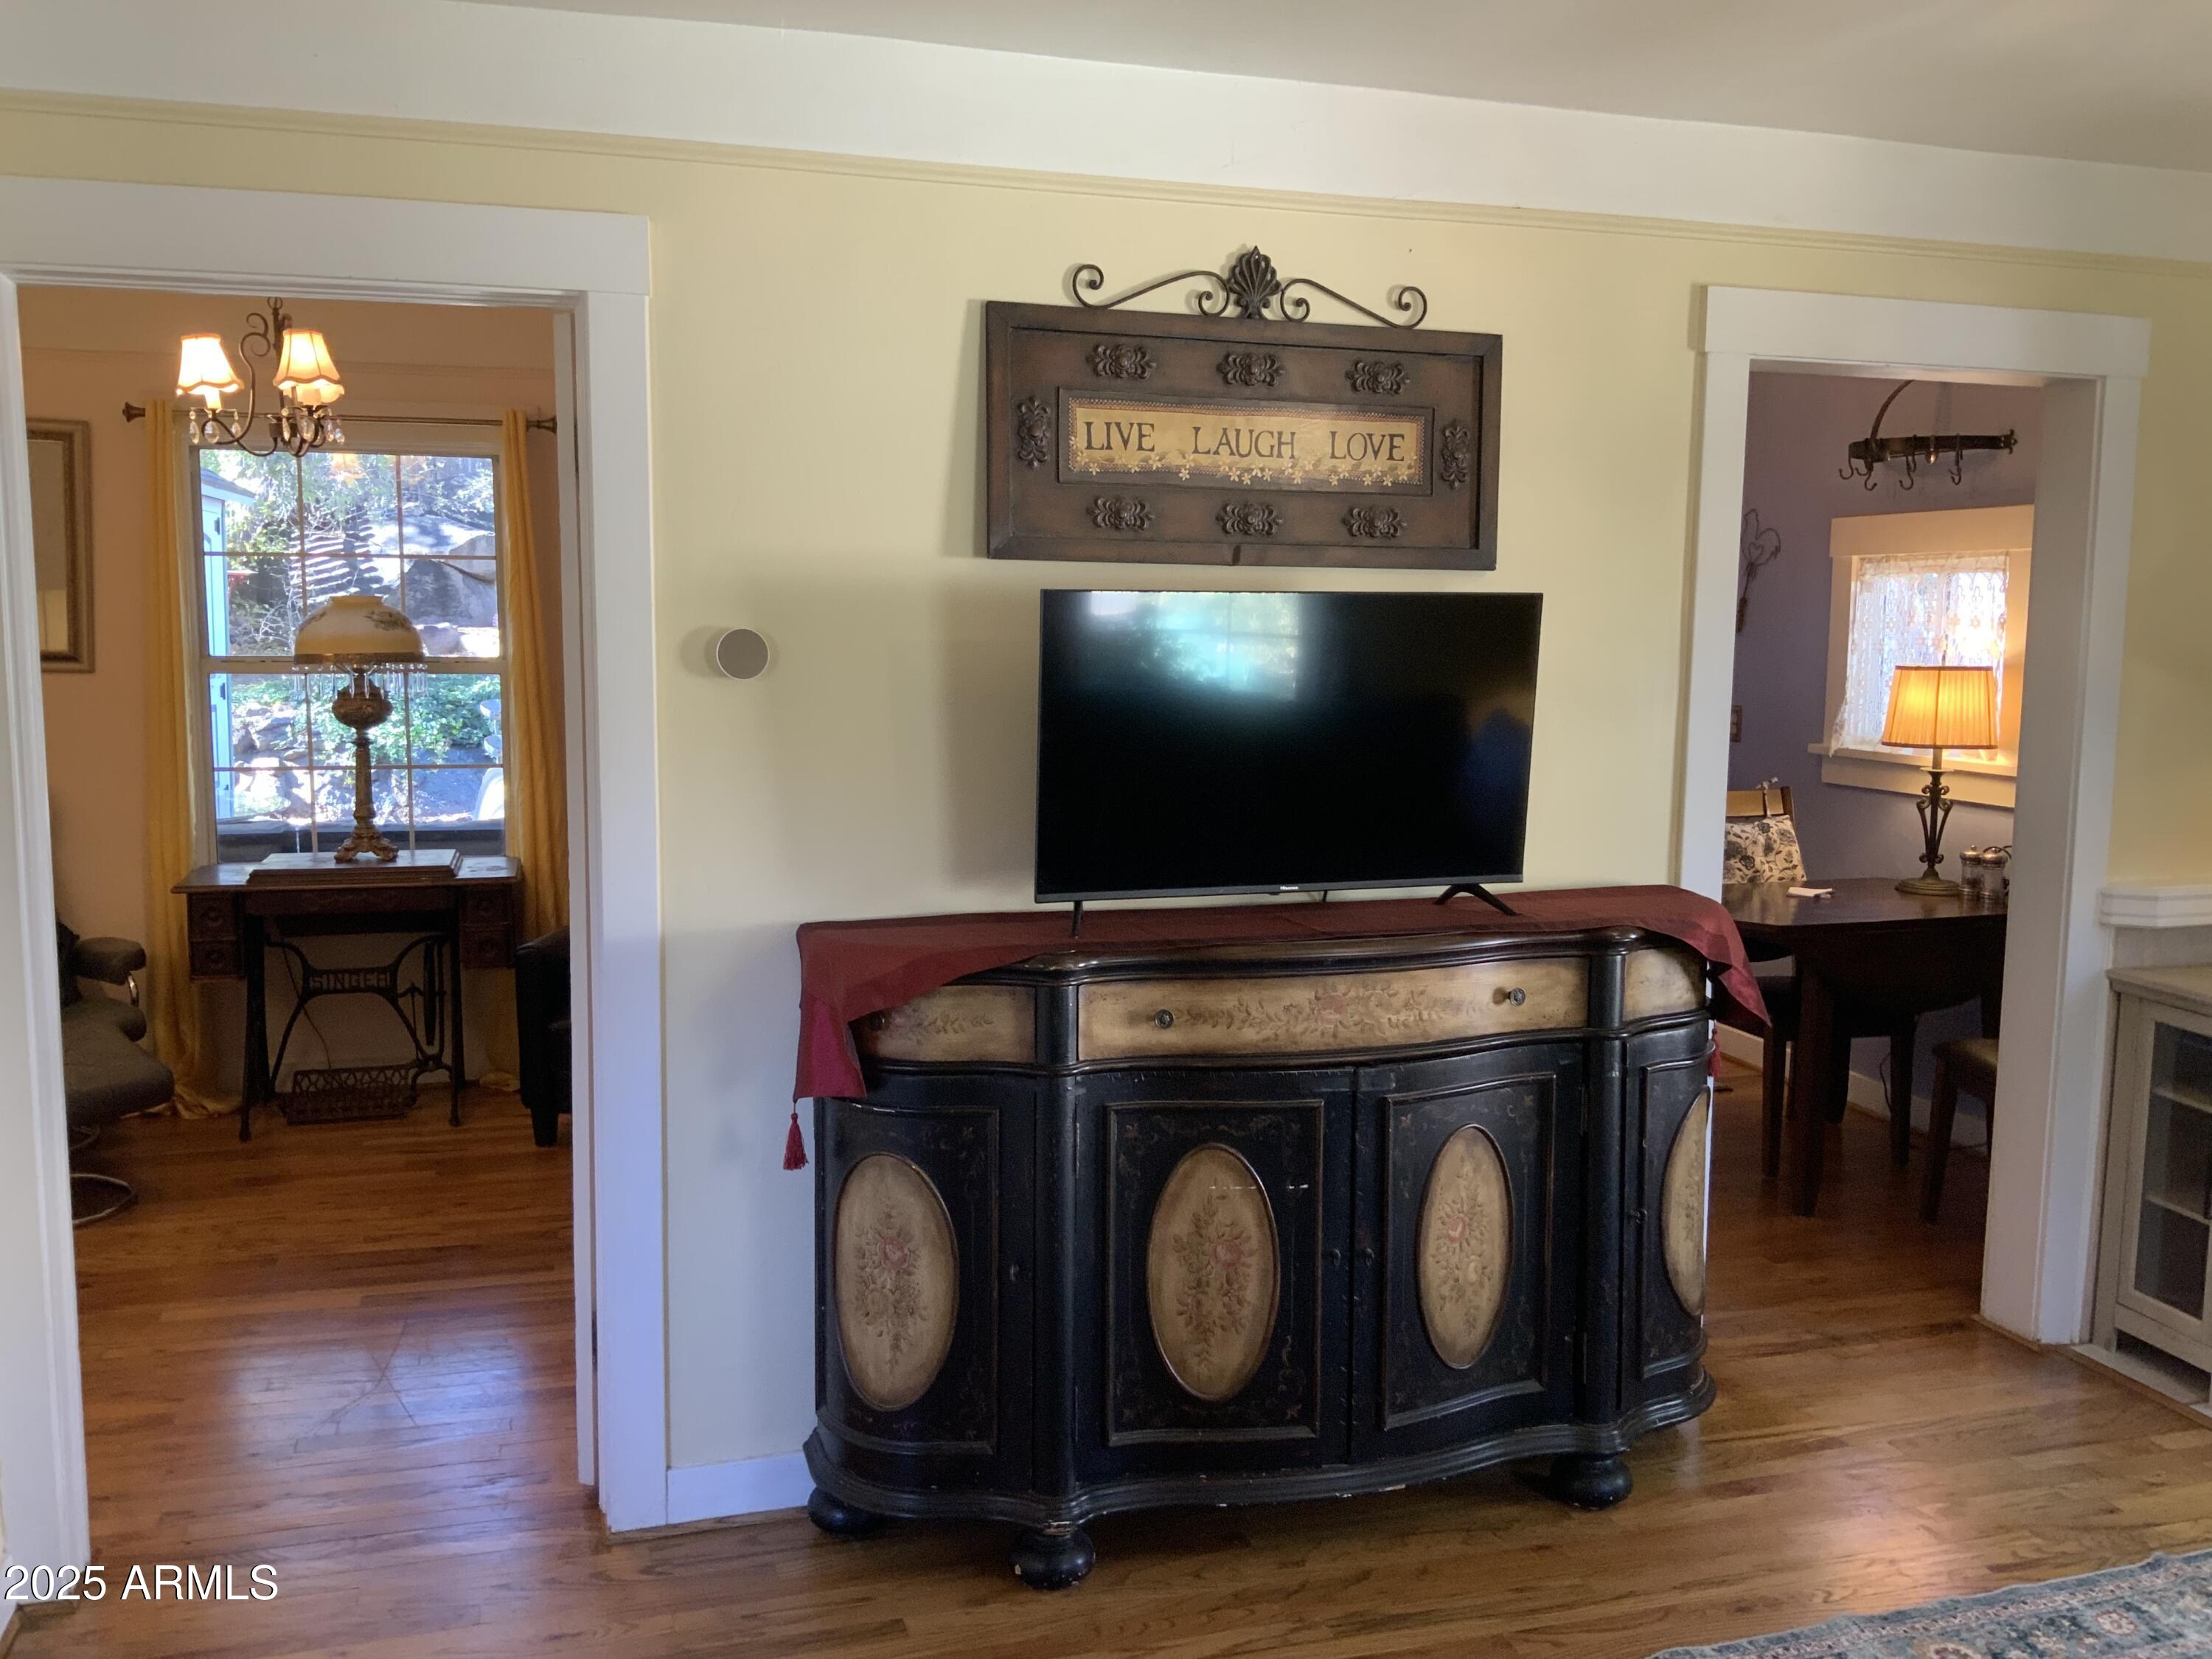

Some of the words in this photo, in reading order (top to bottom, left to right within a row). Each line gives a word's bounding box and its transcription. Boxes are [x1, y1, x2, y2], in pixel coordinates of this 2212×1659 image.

[1083, 421, 1155, 452] LIVE
[1192, 426, 1296, 459] LAUGH
[1329, 431, 1405, 462] LOVE
